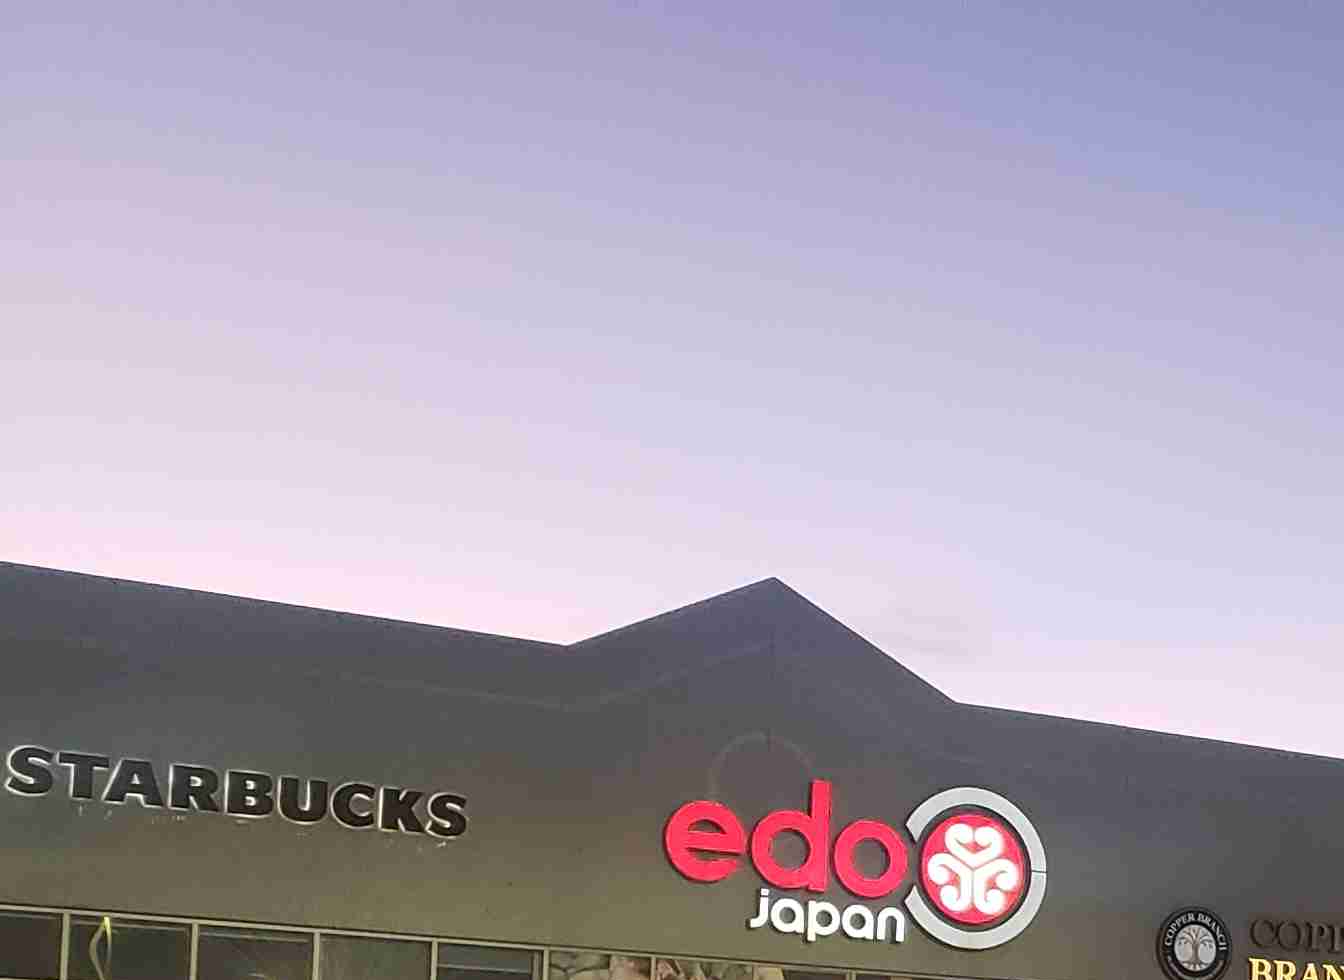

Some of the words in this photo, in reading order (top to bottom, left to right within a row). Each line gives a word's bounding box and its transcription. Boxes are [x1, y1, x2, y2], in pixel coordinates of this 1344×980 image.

[5, 745, 470, 838] STARBUCKS
[664, 779, 909, 899] edo
[748, 888, 906, 943] japan
[1164, 912, 1196, 946] COPPER
